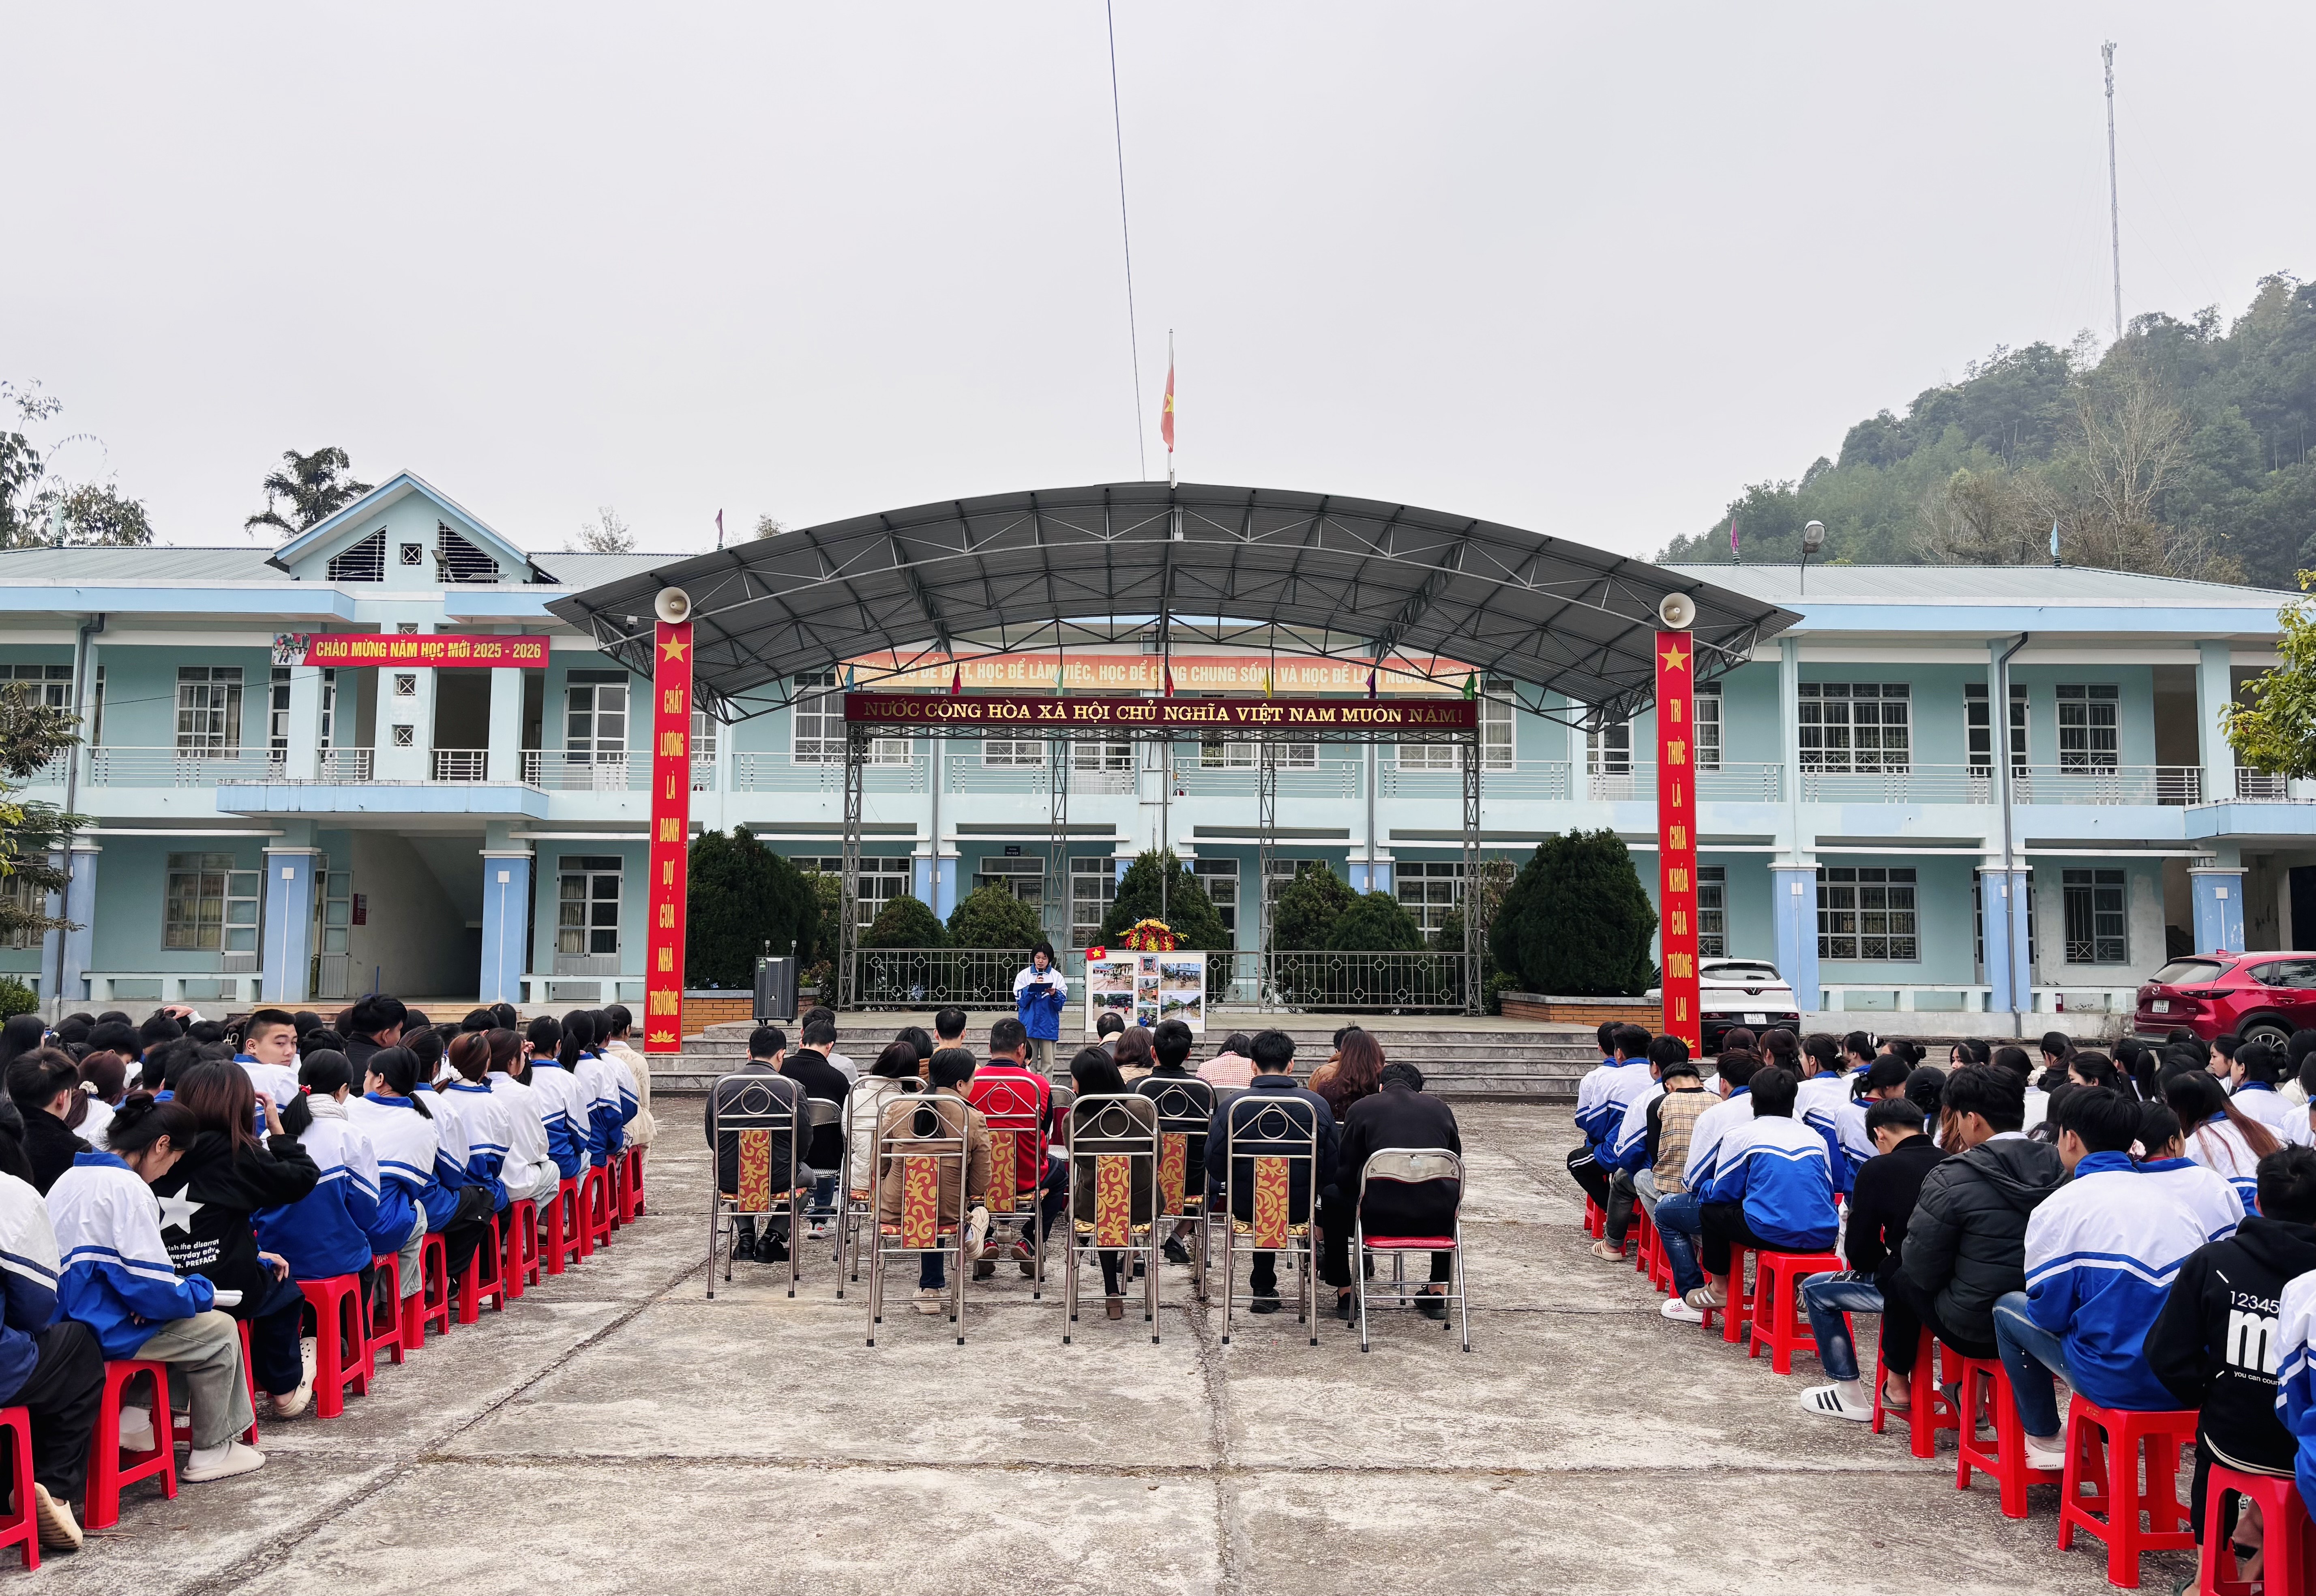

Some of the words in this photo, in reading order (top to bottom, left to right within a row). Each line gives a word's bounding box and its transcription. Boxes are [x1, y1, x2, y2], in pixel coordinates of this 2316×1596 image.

[316, 639, 348, 657] CHÀO
[351, 639, 387, 657] MỪNG
[390, 639, 418, 657] NĂM
[420, 642, 444, 661] HỌC
[447, 639, 470, 658] MỚI
[473, 643, 502, 658] 2025
[513, 643, 541, 658] 2026
[977, 664, 1004, 682] HỌC
[1008, 658, 1026, 679] ĐỂ
[1029, 661, 1057, 680] LÀM
[1063, 661, 1094, 682] VIỆC,
[1099, 665, 1126, 684] HỌC
[1130, 660, 1147, 681] ĐỂ
[1191, 666, 1236, 682] CHUNG
[1240, 662, 1276, 682] SỐNG
[1280, 664, 1297, 683] VÀ
[1301, 667, 1328, 686] HỌC
[1332, 662, 1350, 683] ĐỂ
[664, 682, 683, 714] CHẤT
[864, 699, 920, 717] NƯỚC
[925, 699, 981, 722] CỘNG
[987, 699, 1031, 719] HÒA
[1037, 701, 1067, 719] XÃ
[1073, 701, 1110, 723] HỘI
[1116, 698, 1157, 720] CHỦ
[1163, 703, 1230, 721] NGHĨA
[1235, 704, 1284, 725] VIỆT
[1289, 708, 1336, 722] NAM
[1341, 704, 1403, 723] MUÔN
[1408, 705, 1463, 723] NĂM!
[1670, 699, 1681, 723] TRI
[660, 730, 684, 762] LƯỢNG
[1667, 736, 1685, 765] THỨC
[666, 770, 676, 799] LÀ
[1672, 778, 1682, 807] LÀ
[659, 817, 680, 842] DANH
[1669, 820, 1687, 849] CHÌA
[663, 858, 675, 890] DỰ
[1669, 862, 1689, 892] KHÓA
[659, 895, 675, 928] CỦA
[1672, 902, 1688, 935] CỦA
[658, 942, 673, 972] NHÀ
[1667, 951, 1692, 978] TƯƠNG
[650, 985, 678, 1016] TRƯỜNG
[1676, 997, 1687, 1021] LAI
[186, 1254, 217, 1268] PREFACE
